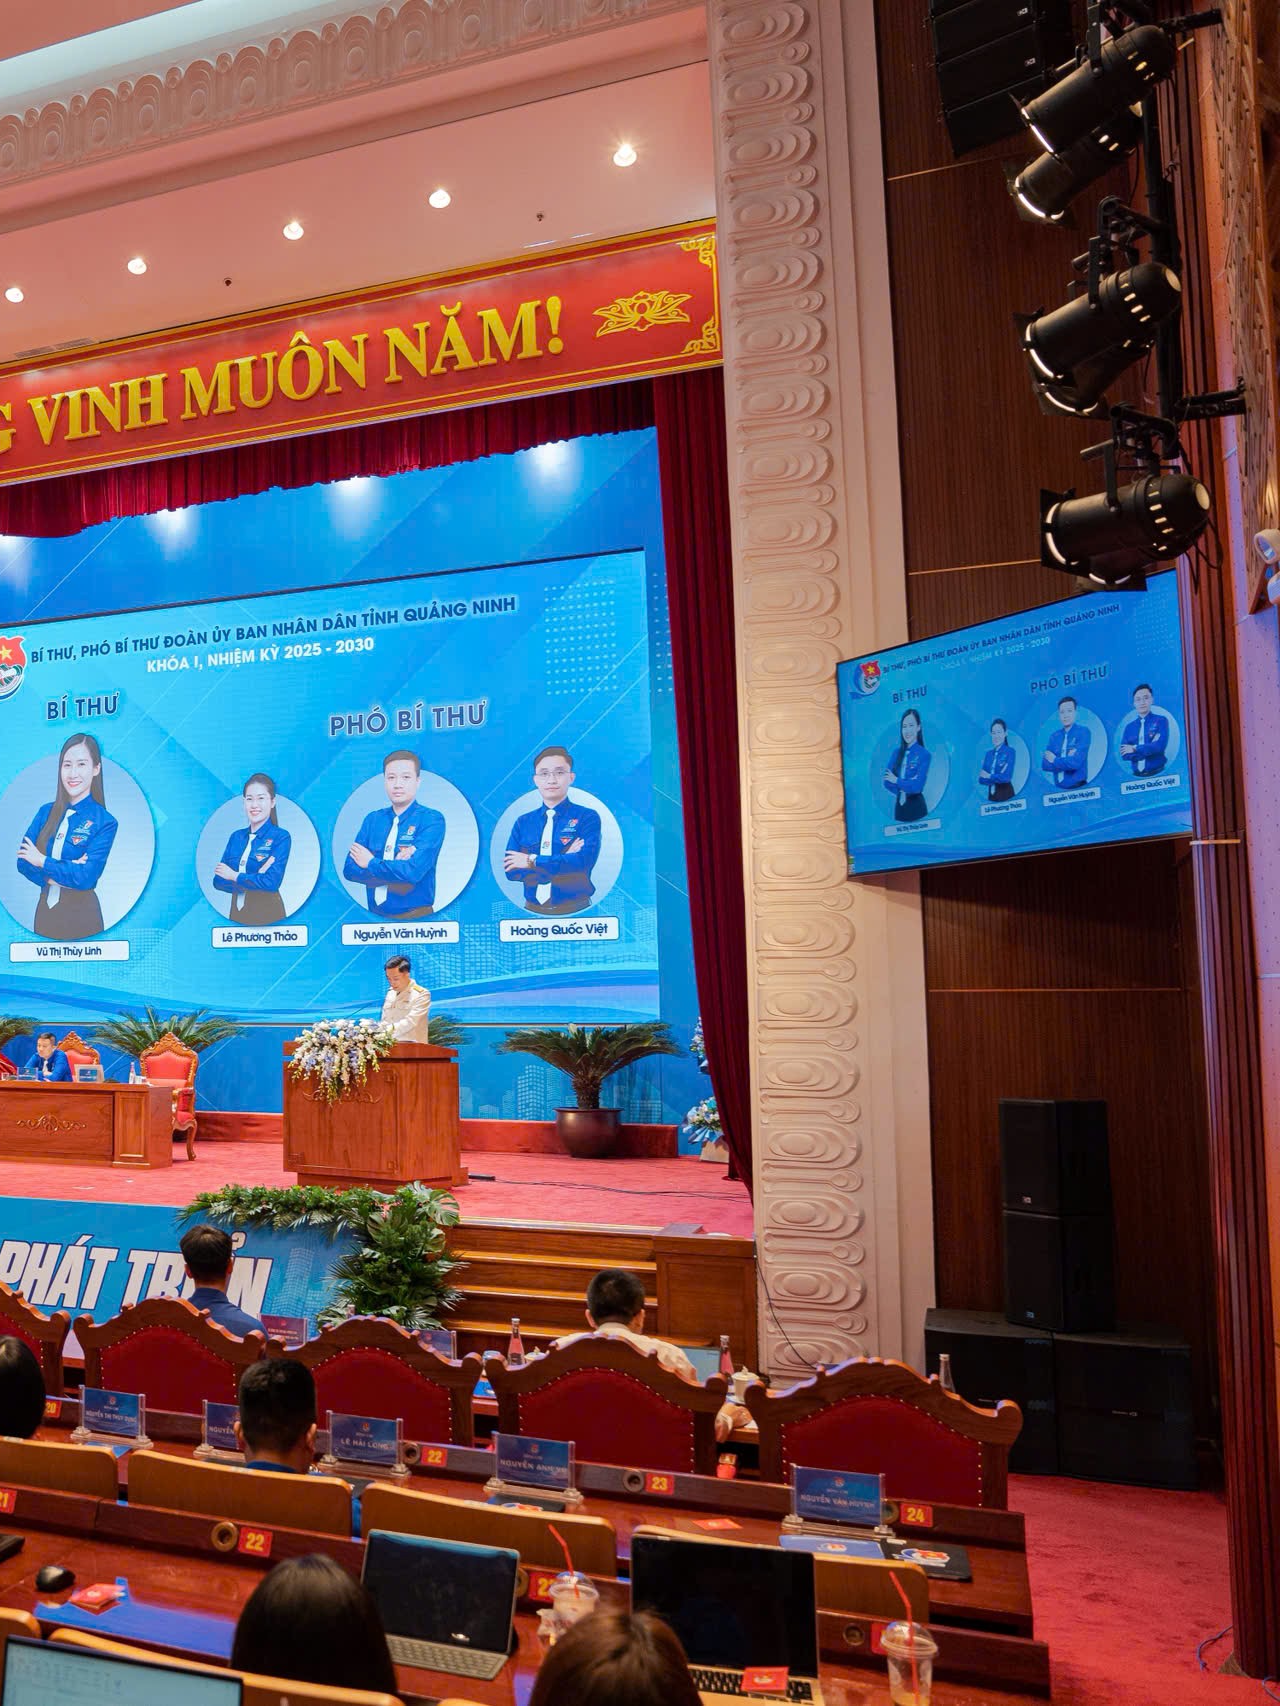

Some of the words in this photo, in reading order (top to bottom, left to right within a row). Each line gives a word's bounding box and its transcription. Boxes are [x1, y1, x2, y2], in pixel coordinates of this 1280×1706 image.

[27, 371, 169, 446] VINH
[180, 332, 369, 421] MUÔN
[384, 294, 565, 385] NĂM!
[31, 647, 43, 663] BÍ
[47, 644, 77, 661] THƯ,
[81, 640, 111, 657] PHÓ
[115, 637, 128, 654] BÍ
[132, 635, 161, 652] THƯ
[163, 630, 208, 648] ĐOÀN
[212, 625, 231, 643] ỦY
[236, 624, 268, 641] BAN
[272, 617, 318, 637] NHÂN
[322, 613, 357, 631] DÂN
[361, 608, 399, 627] TỈNH
[404, 600, 467, 622] QUẢNG
[472, 596, 516, 615] NINH
[146, 657, 190, 673] KHÓA
[194, 655, 204, 671] I,
[207, 648, 255, 668] NHIỆM
[260, 643, 279, 662] KỲ
[284, 642, 322, 659] 2025
[335, 637, 374, 654] 2030
[47, 695, 69, 720] BÍ
[75, 692, 120, 718] THƯ
[330, 706, 387, 736] PHÓ
[398, 702, 423, 731] BÍ
[432, 700, 487, 728] THƯ
[222, 931, 232, 942] Lê
[234, 931, 271, 944] Phương
[273, 930, 298, 942] Thảo
[353, 925, 392, 942] Nguyễn
[393, 927, 414, 939] Văn
[415, 927, 448, 941] Huỳnh
[510, 924, 549, 938] Hoàng
[551, 922, 583, 936] Quốc
[585, 922, 609, 937] Việt
[36, 946, 48, 957] Vũ
[49, 946, 62, 958] Thị
[84, 946, 102, 957] Linh
[427, 1449, 442, 1464] 22
[651, 1476, 668, 1492] 23
[906, 1507, 925, 1522] 24
[244, 1532, 265, 1552] 22
